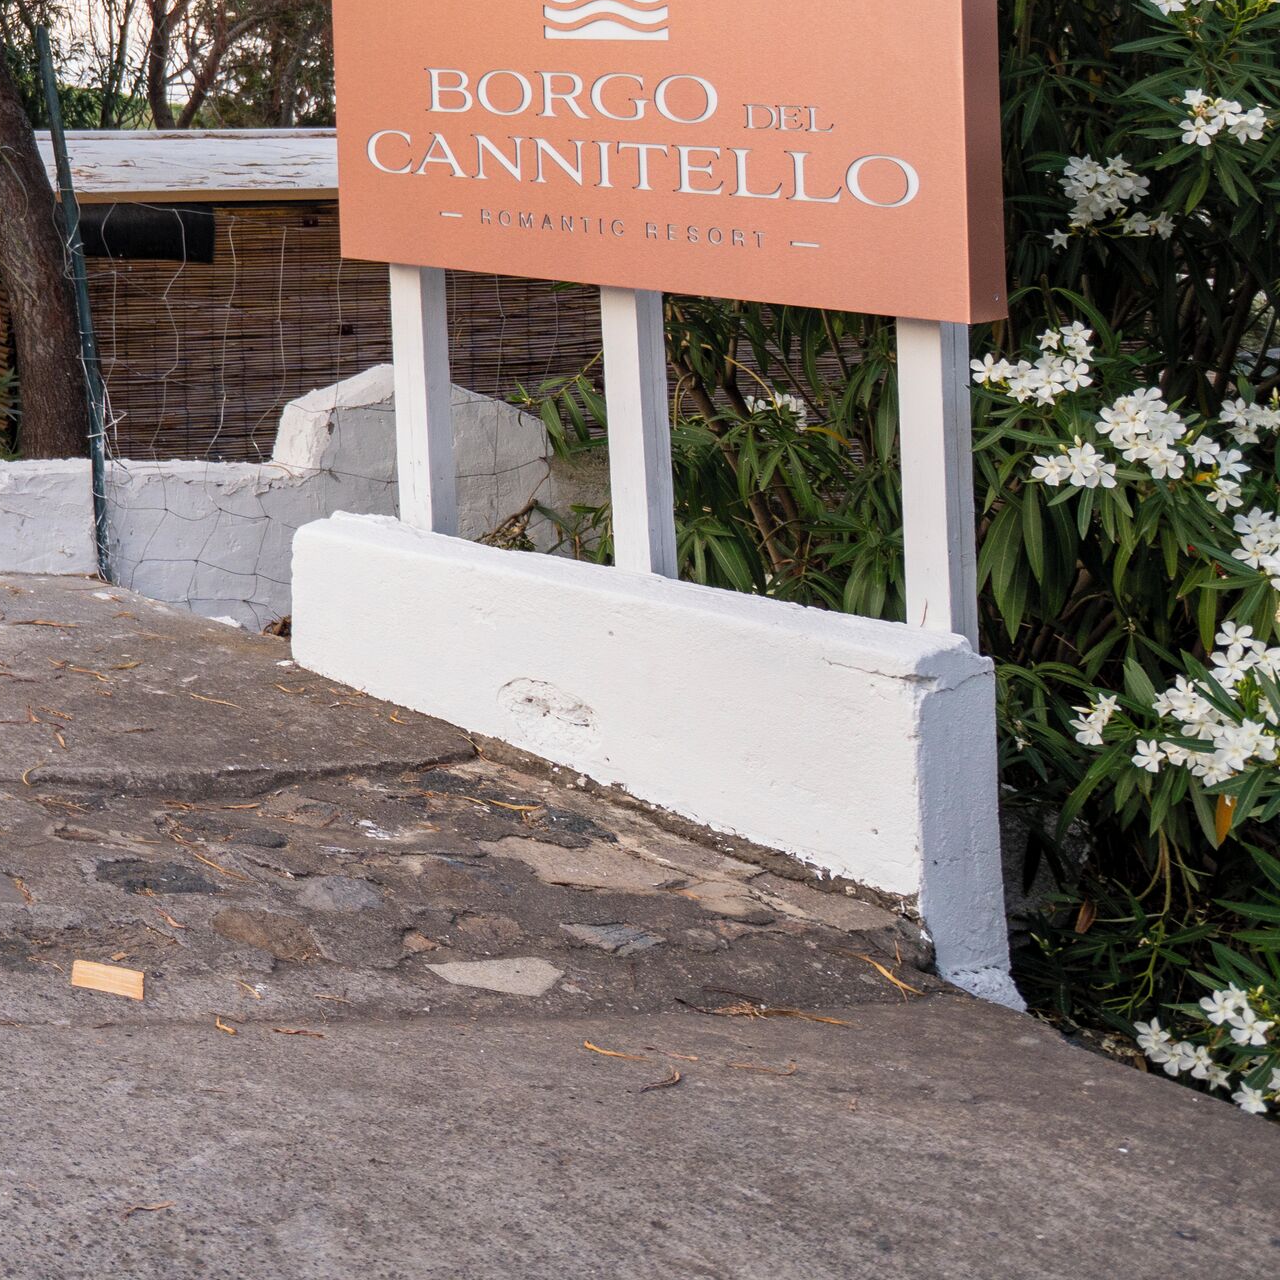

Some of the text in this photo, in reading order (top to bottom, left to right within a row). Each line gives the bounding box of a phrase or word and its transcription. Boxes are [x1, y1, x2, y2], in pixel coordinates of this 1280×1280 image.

[425, 67, 834, 132] BORGO DEL
[366, 130, 920, 208] CANNITELLO
[480, 208, 767, 249] ROMANTIC RESORT
